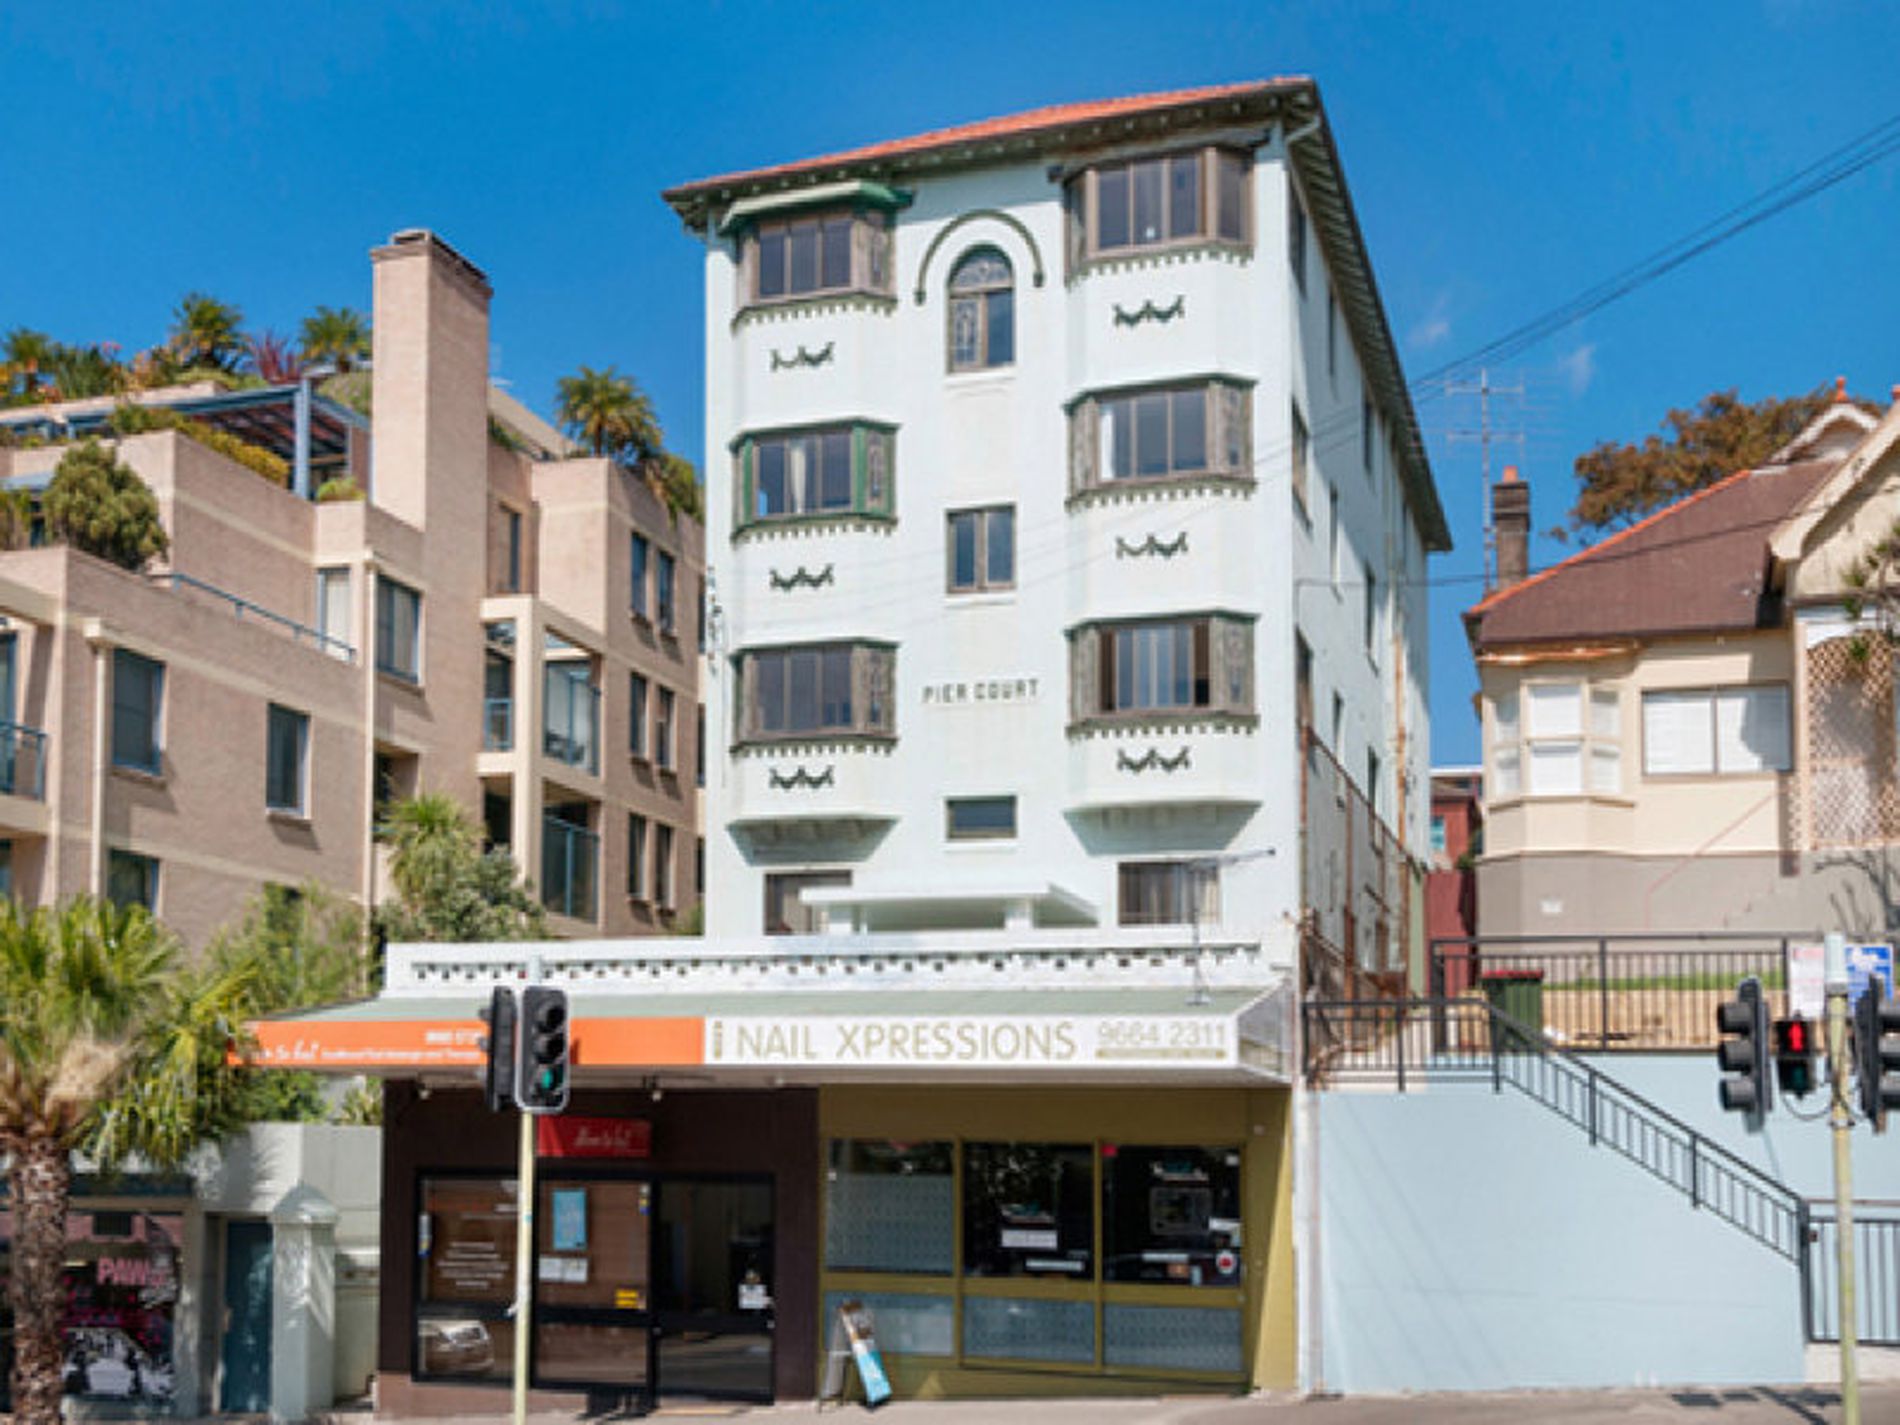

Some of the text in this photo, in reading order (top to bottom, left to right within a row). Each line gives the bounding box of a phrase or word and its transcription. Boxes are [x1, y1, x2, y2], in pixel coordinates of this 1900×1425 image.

[921, 678, 1039, 704] PIER COURT
[737, 1024, 817, 1059] NAIL
[836, 1021, 1077, 1060] XPRESSIONS
[1098, 1020, 1226, 1046] 9664 2311
